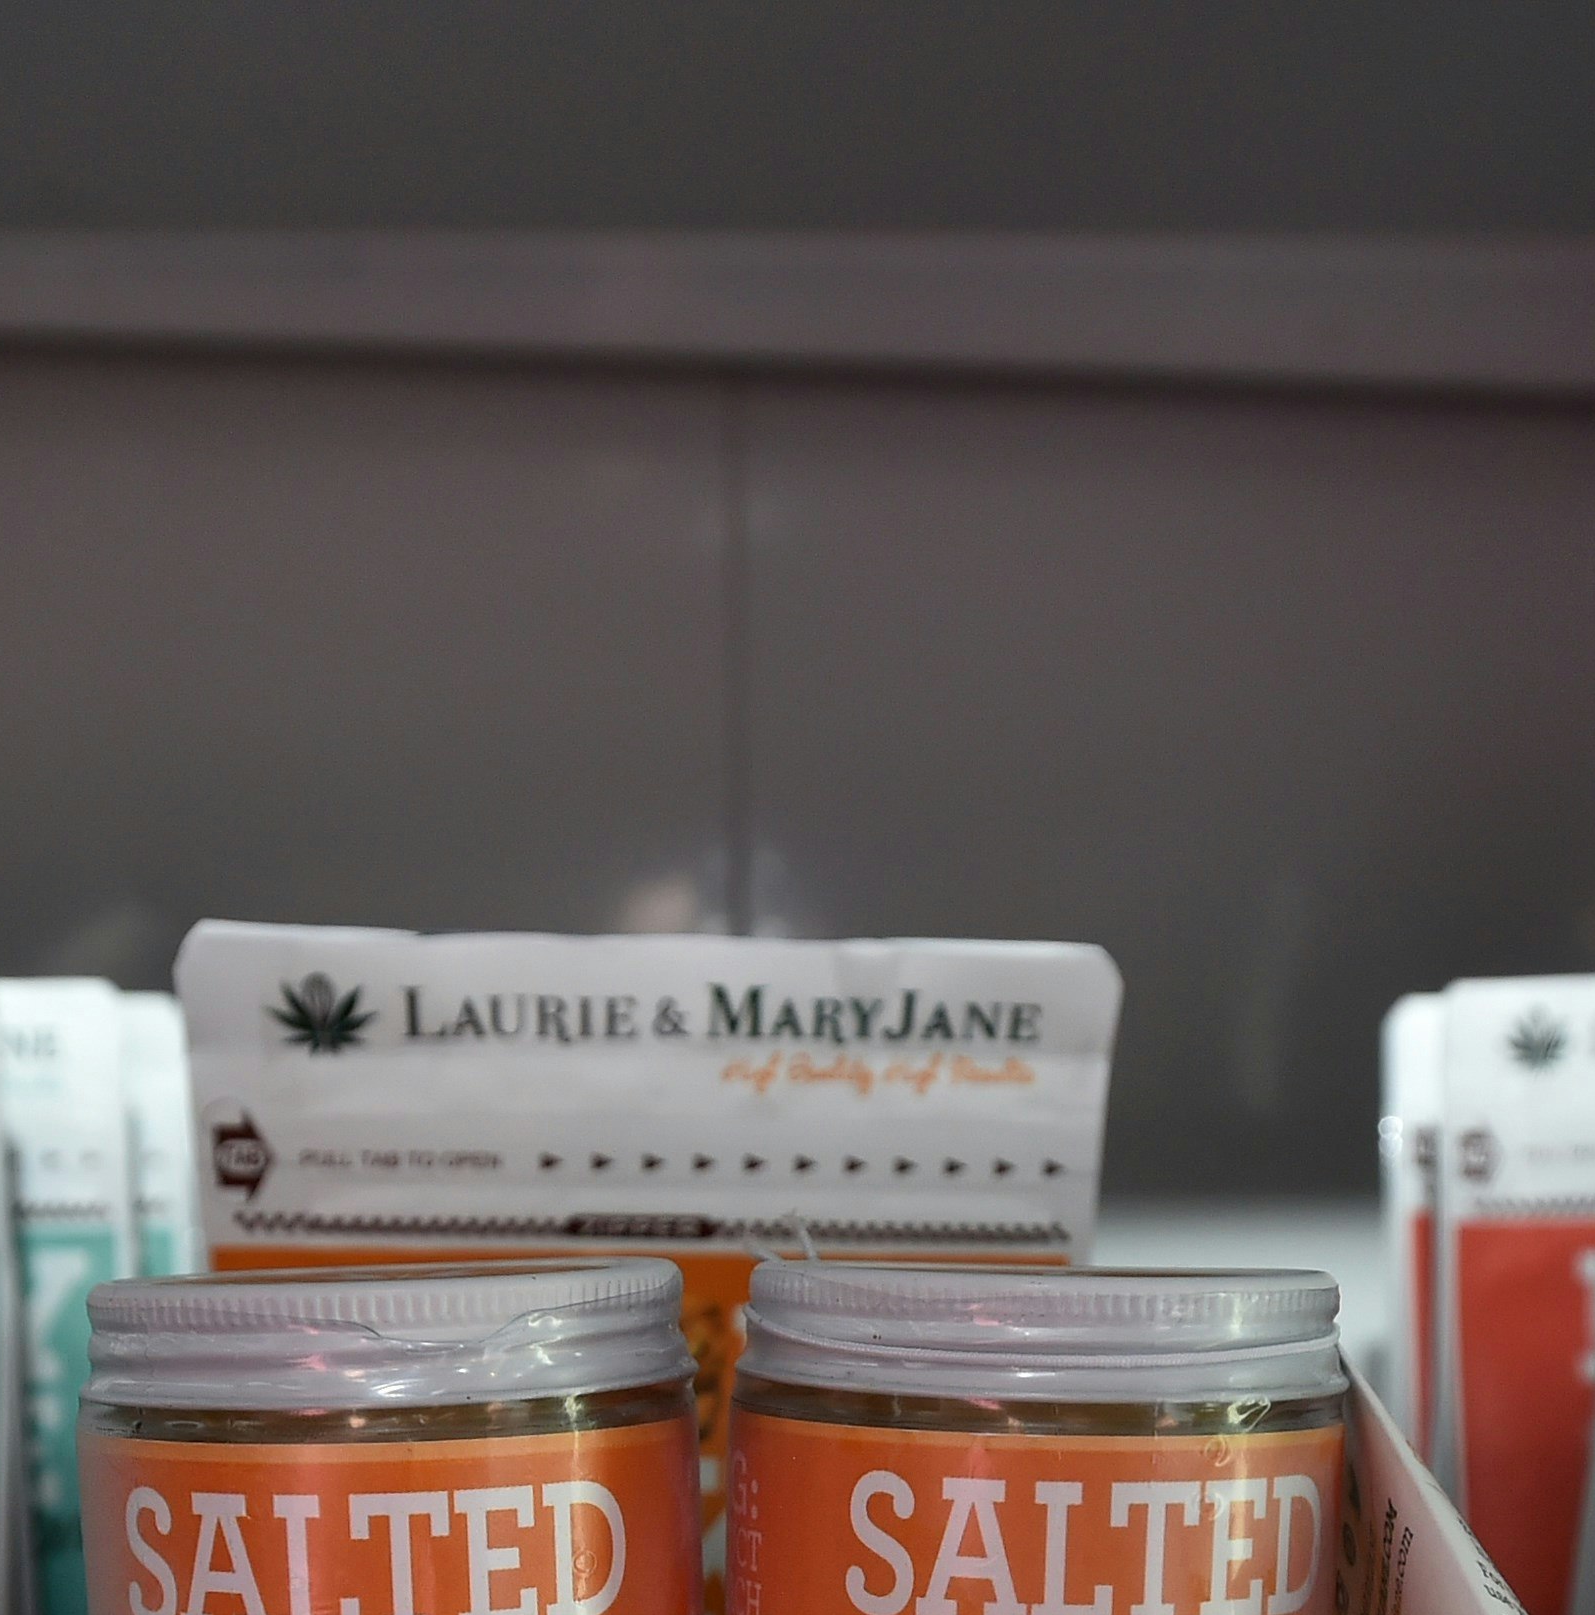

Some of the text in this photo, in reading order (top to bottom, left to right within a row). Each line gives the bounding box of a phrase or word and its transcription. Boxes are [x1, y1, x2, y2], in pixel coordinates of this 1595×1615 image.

[401, 981, 1044, 1044] LAURIE & MARYJANE
